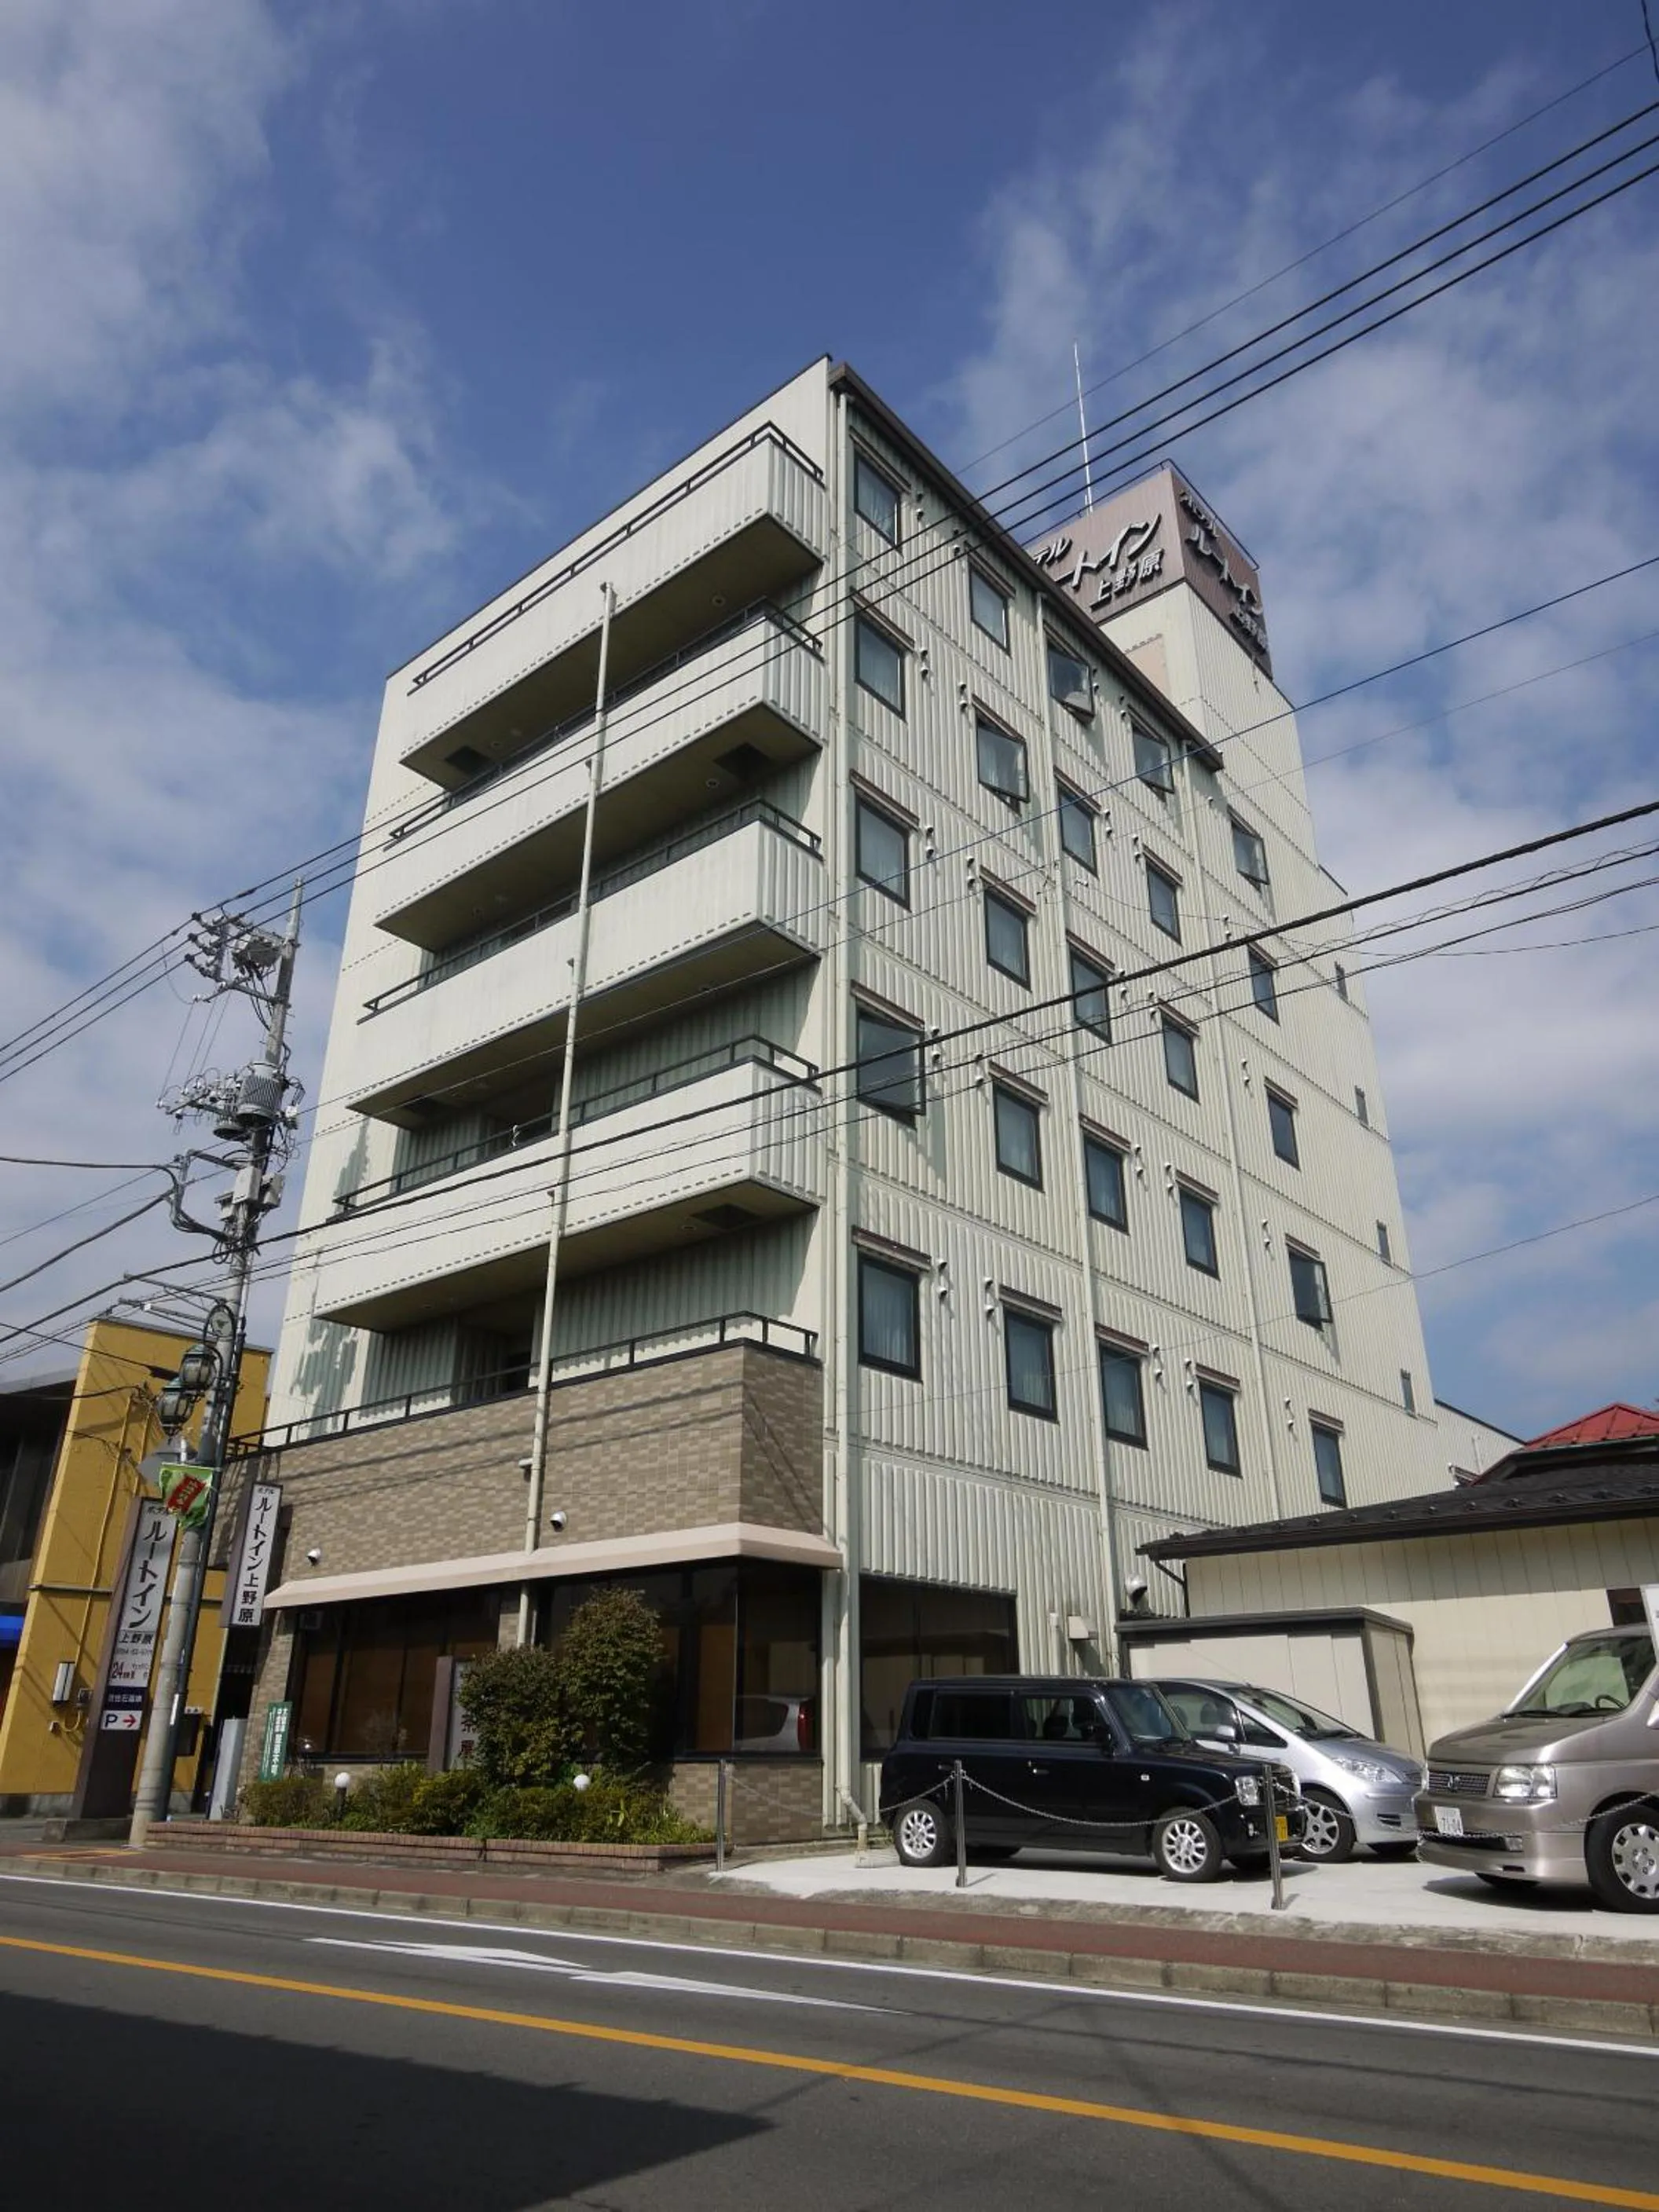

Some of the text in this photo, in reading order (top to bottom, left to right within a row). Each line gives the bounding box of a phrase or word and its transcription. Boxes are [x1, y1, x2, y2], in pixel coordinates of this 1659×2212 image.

[1089, 548, 1165, 611] 上野原
[128, 1521, 167, 1628] ルートイン
[230, 1497, 272, 1623] ルートイン上野原
[119, 1632, 154, 1644] 上野原
[104, 1713, 118, 1727] P
